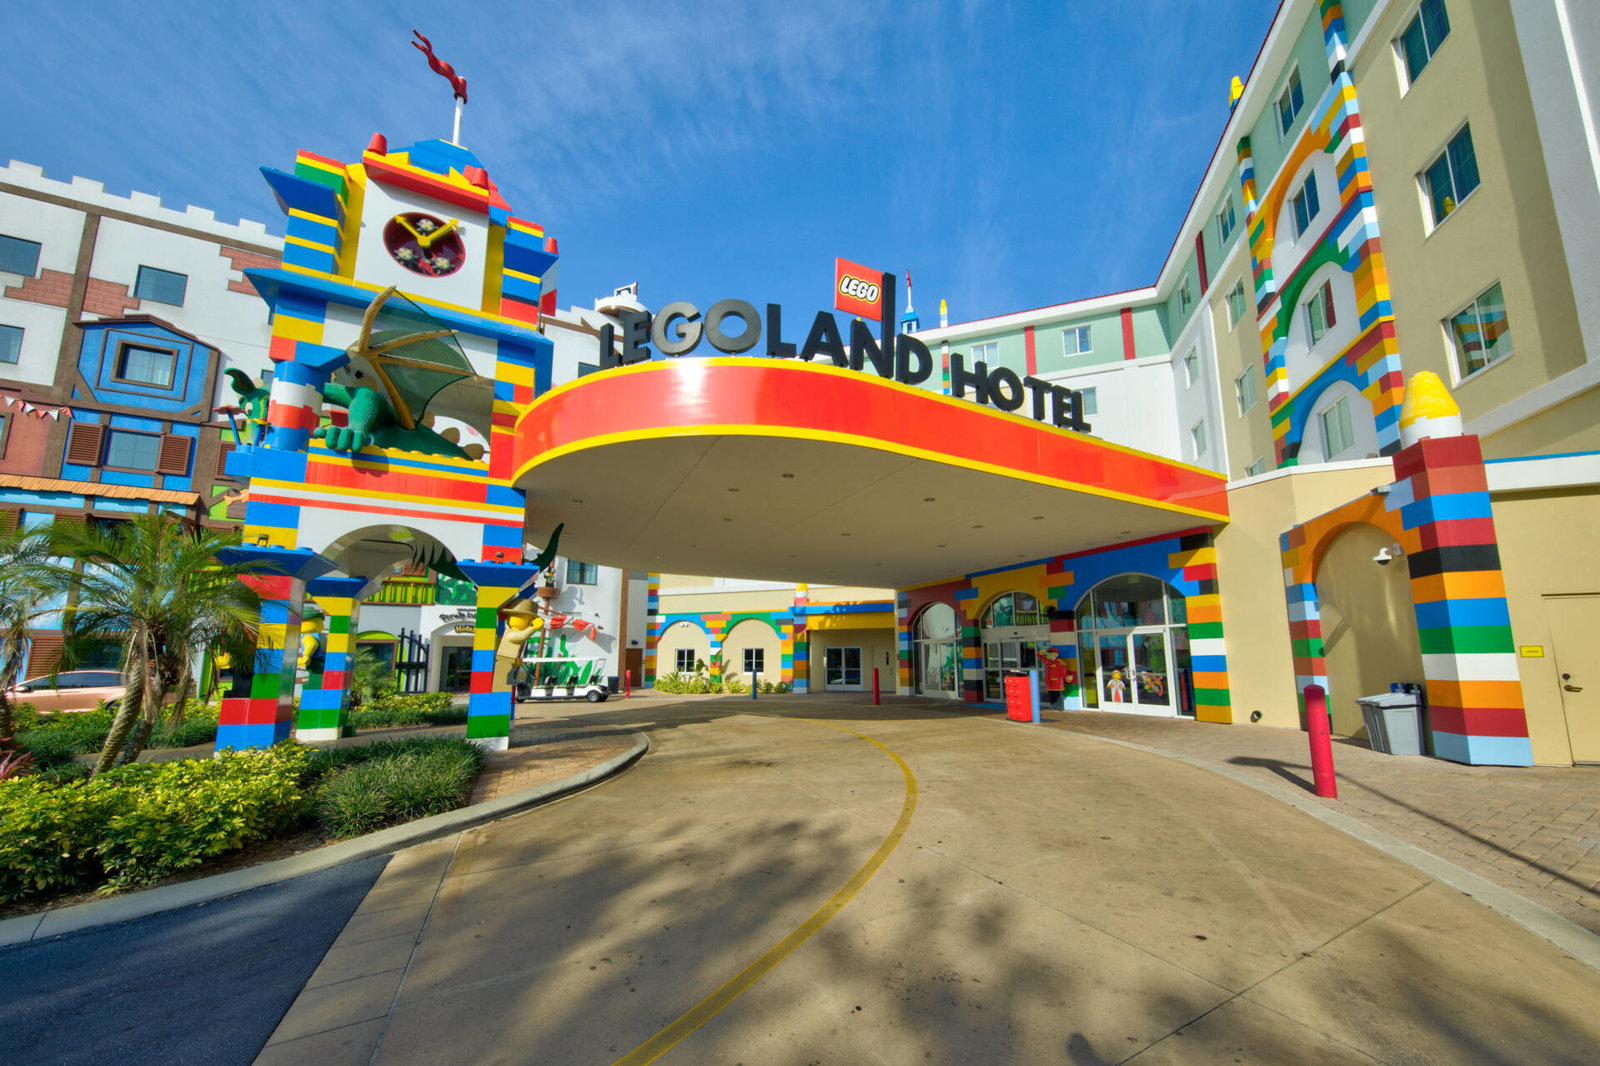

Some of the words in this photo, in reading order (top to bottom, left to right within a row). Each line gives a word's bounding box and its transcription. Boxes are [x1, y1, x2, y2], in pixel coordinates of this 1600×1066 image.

[840, 275, 879, 302] LEGO
[600, 273, 932, 385] LEGOLAND
[951, 353, 1091, 433] HOTEL
